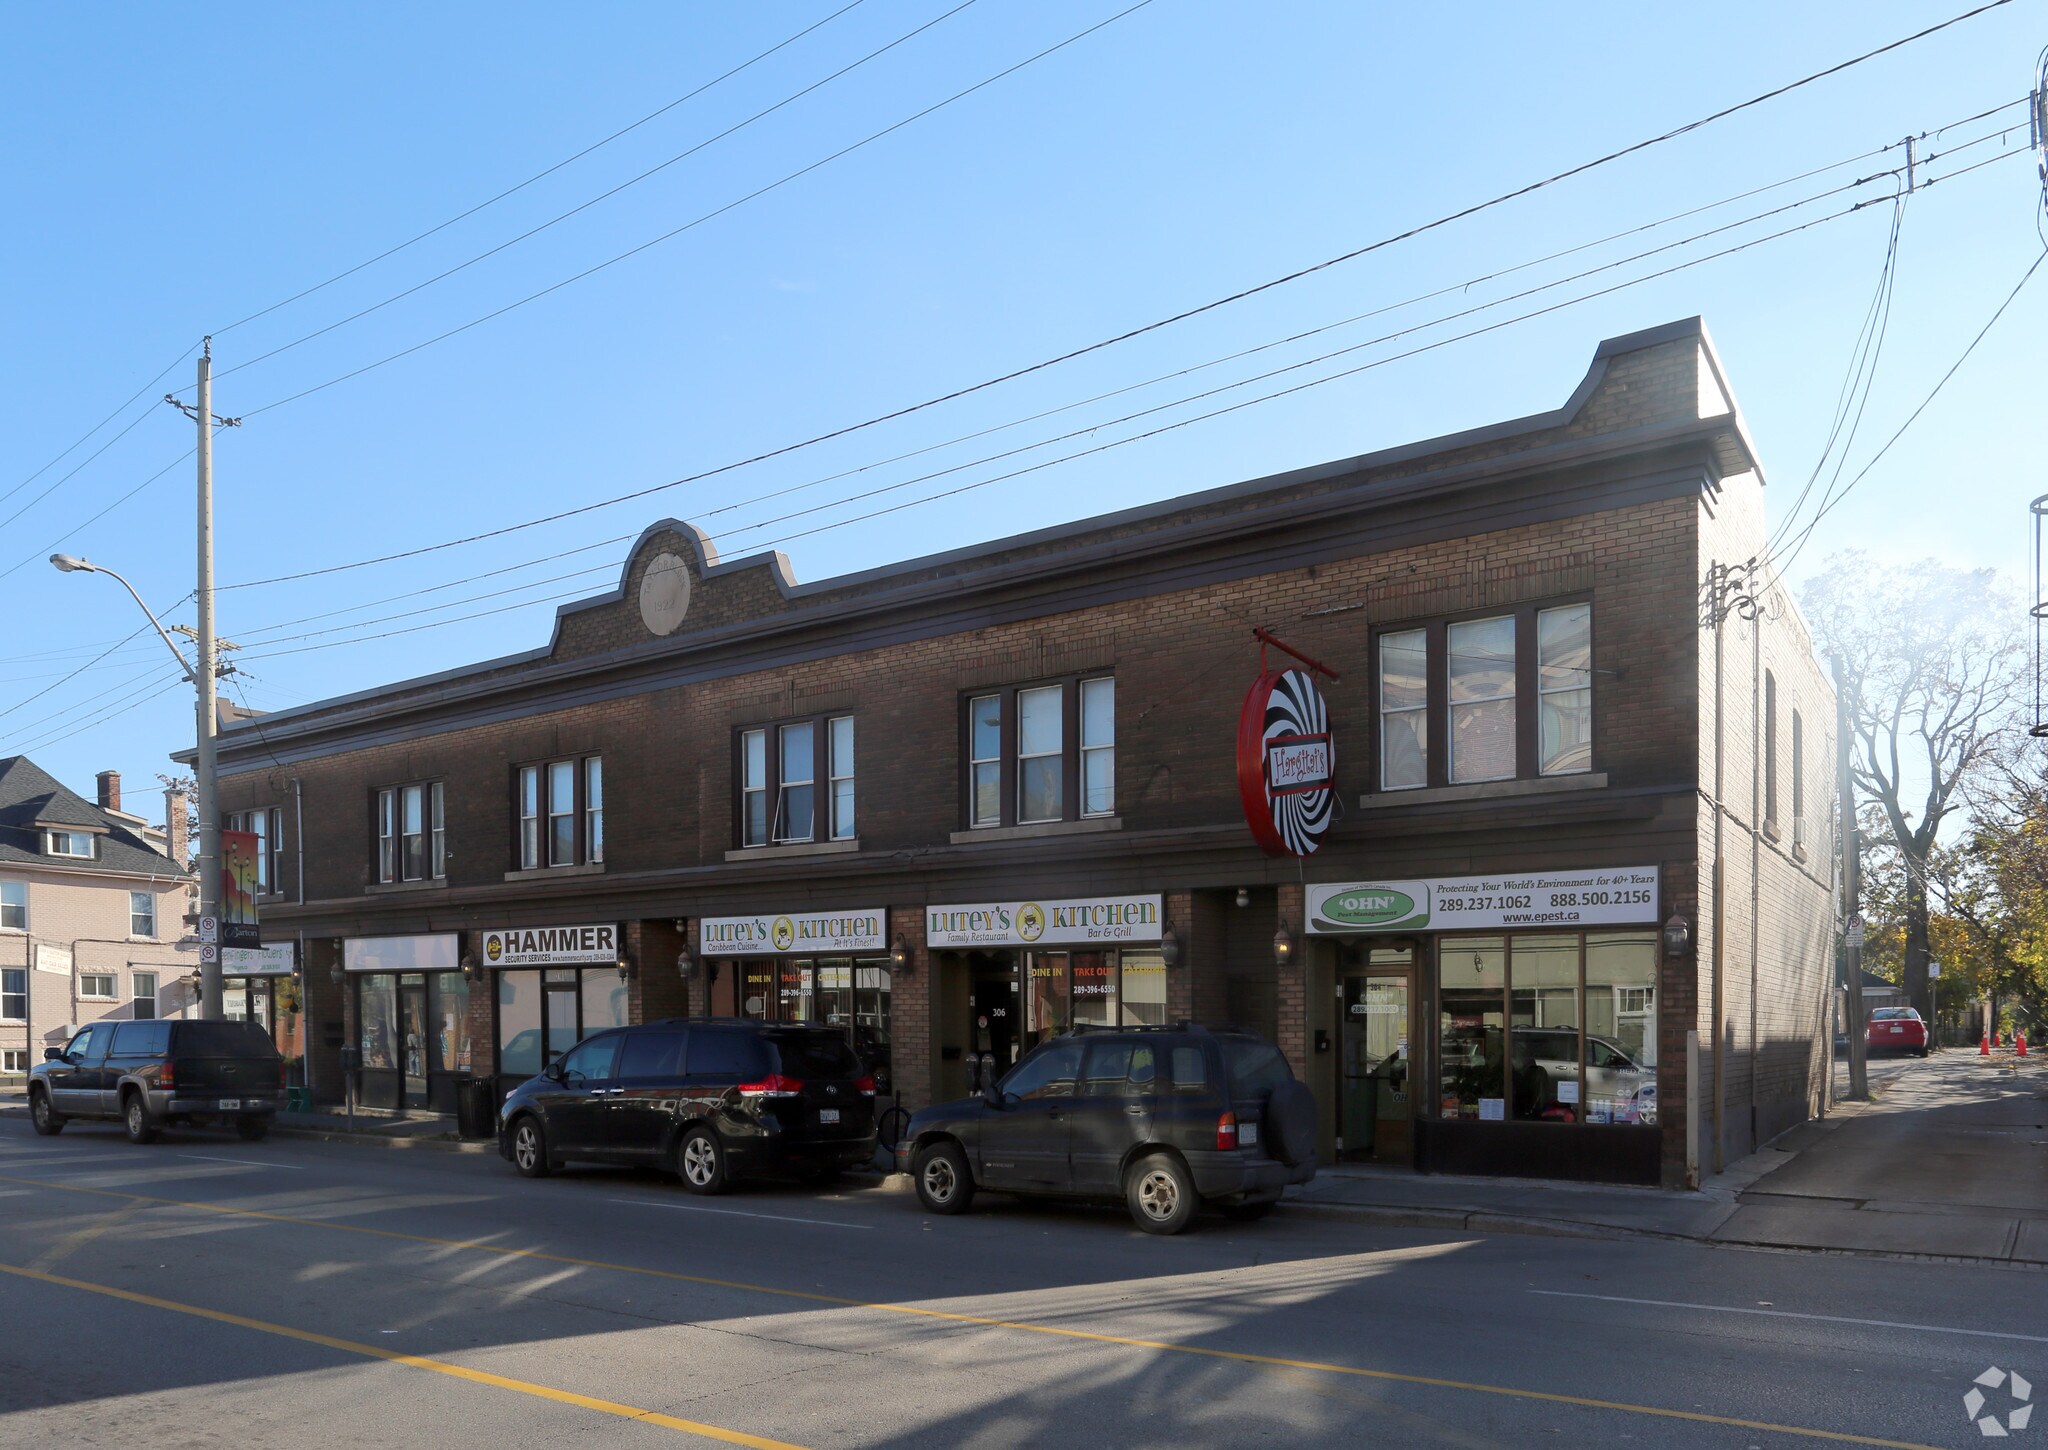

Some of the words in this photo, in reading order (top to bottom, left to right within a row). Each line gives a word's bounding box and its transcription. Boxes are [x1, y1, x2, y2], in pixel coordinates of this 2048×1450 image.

[1273, 747, 1325, 784] Hargitai's
[1436, 884, 1479, 894] Protecting
[1481, 882, 1501, 892] Your
[1503, 880, 1535, 890] World's
[1537, 877, 1594, 889] Environment
[1596, 876, 1610, 887] for
[1611, 876, 1629, 886] 40+
[1630, 875, 1655, 884] Years
[1439, 895, 1532, 911] 289.237.1062
[1550, 890, 1651, 907] 888.500.2156
[1503, 911, 1580, 924] www.epest.ca
[224, 926, 258, 938] Barton
[947, 933, 969, 944] Family
[971, 932, 1009, 942] Restaurant
[1088, 928, 1102, 938] Bar
[1103, 928, 1112, 938] &
[1113, 927, 1132, 939] Grill
[504, 926, 614, 954] HAMMER
[854, 937, 876, 947] Finest!
[708, 943, 736, 952] Caribbean
[504, 955, 527, 963] SECURITY
[528, 954, 551, 963] SERVICES
[748, 975, 762, 983] DINE
[763, 974, 772, 983] IN
[781, 974, 797, 982] TAKE
[798, 973, 812, 982] OUT
[1031, 968, 1050, 977] DINE
[1053, 968, 1062, 976] IN
[1074, 967, 1094, 976] TAKE
[1096, 967, 1115, 976] OUT
[1074, 985, 1116, 994] 289-396-6550
[992, 1008, 1006, 1017] 306
